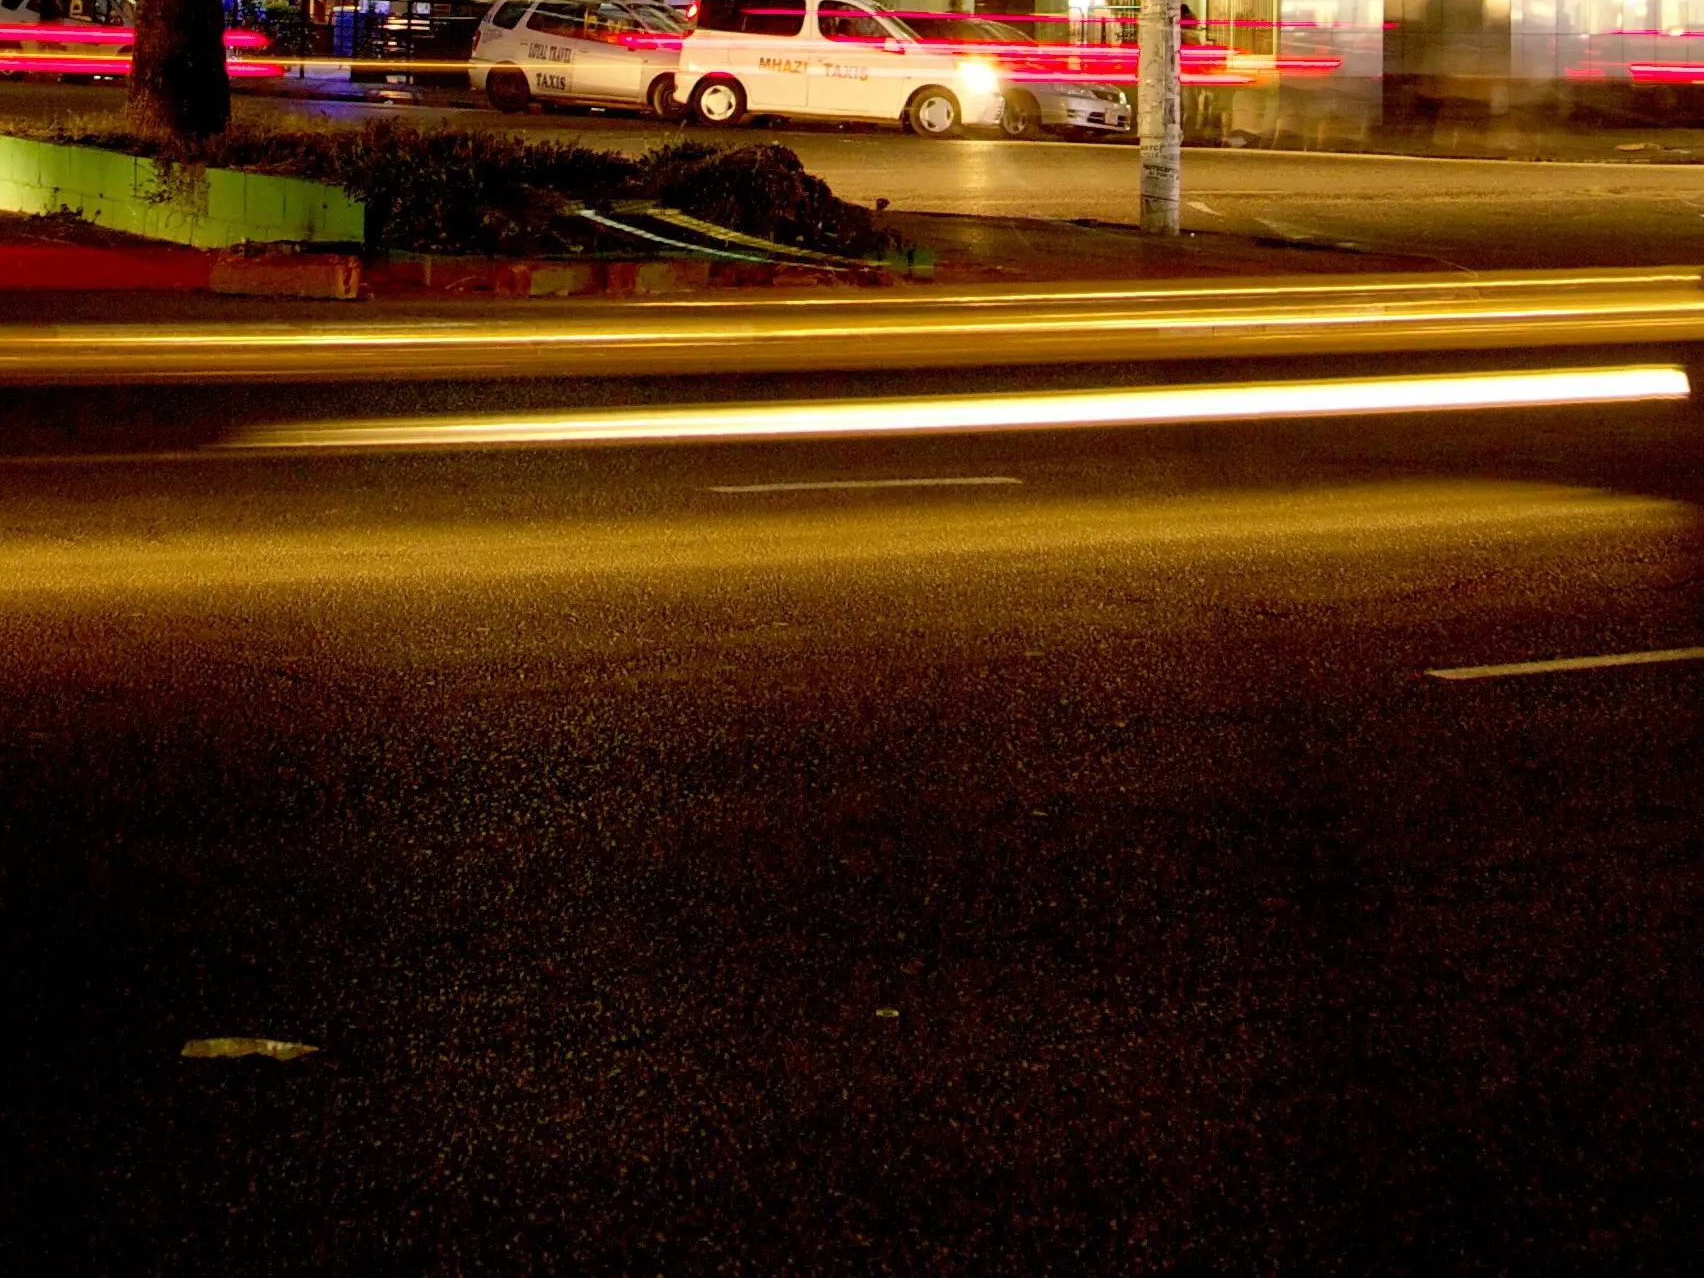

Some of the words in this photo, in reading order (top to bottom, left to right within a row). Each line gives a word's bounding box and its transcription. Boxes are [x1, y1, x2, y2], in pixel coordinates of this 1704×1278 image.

[759, 57, 808, 75] MHAZI
[823, 62, 869, 82] TAXIS
[535, 72, 566, 91] TAXIS
